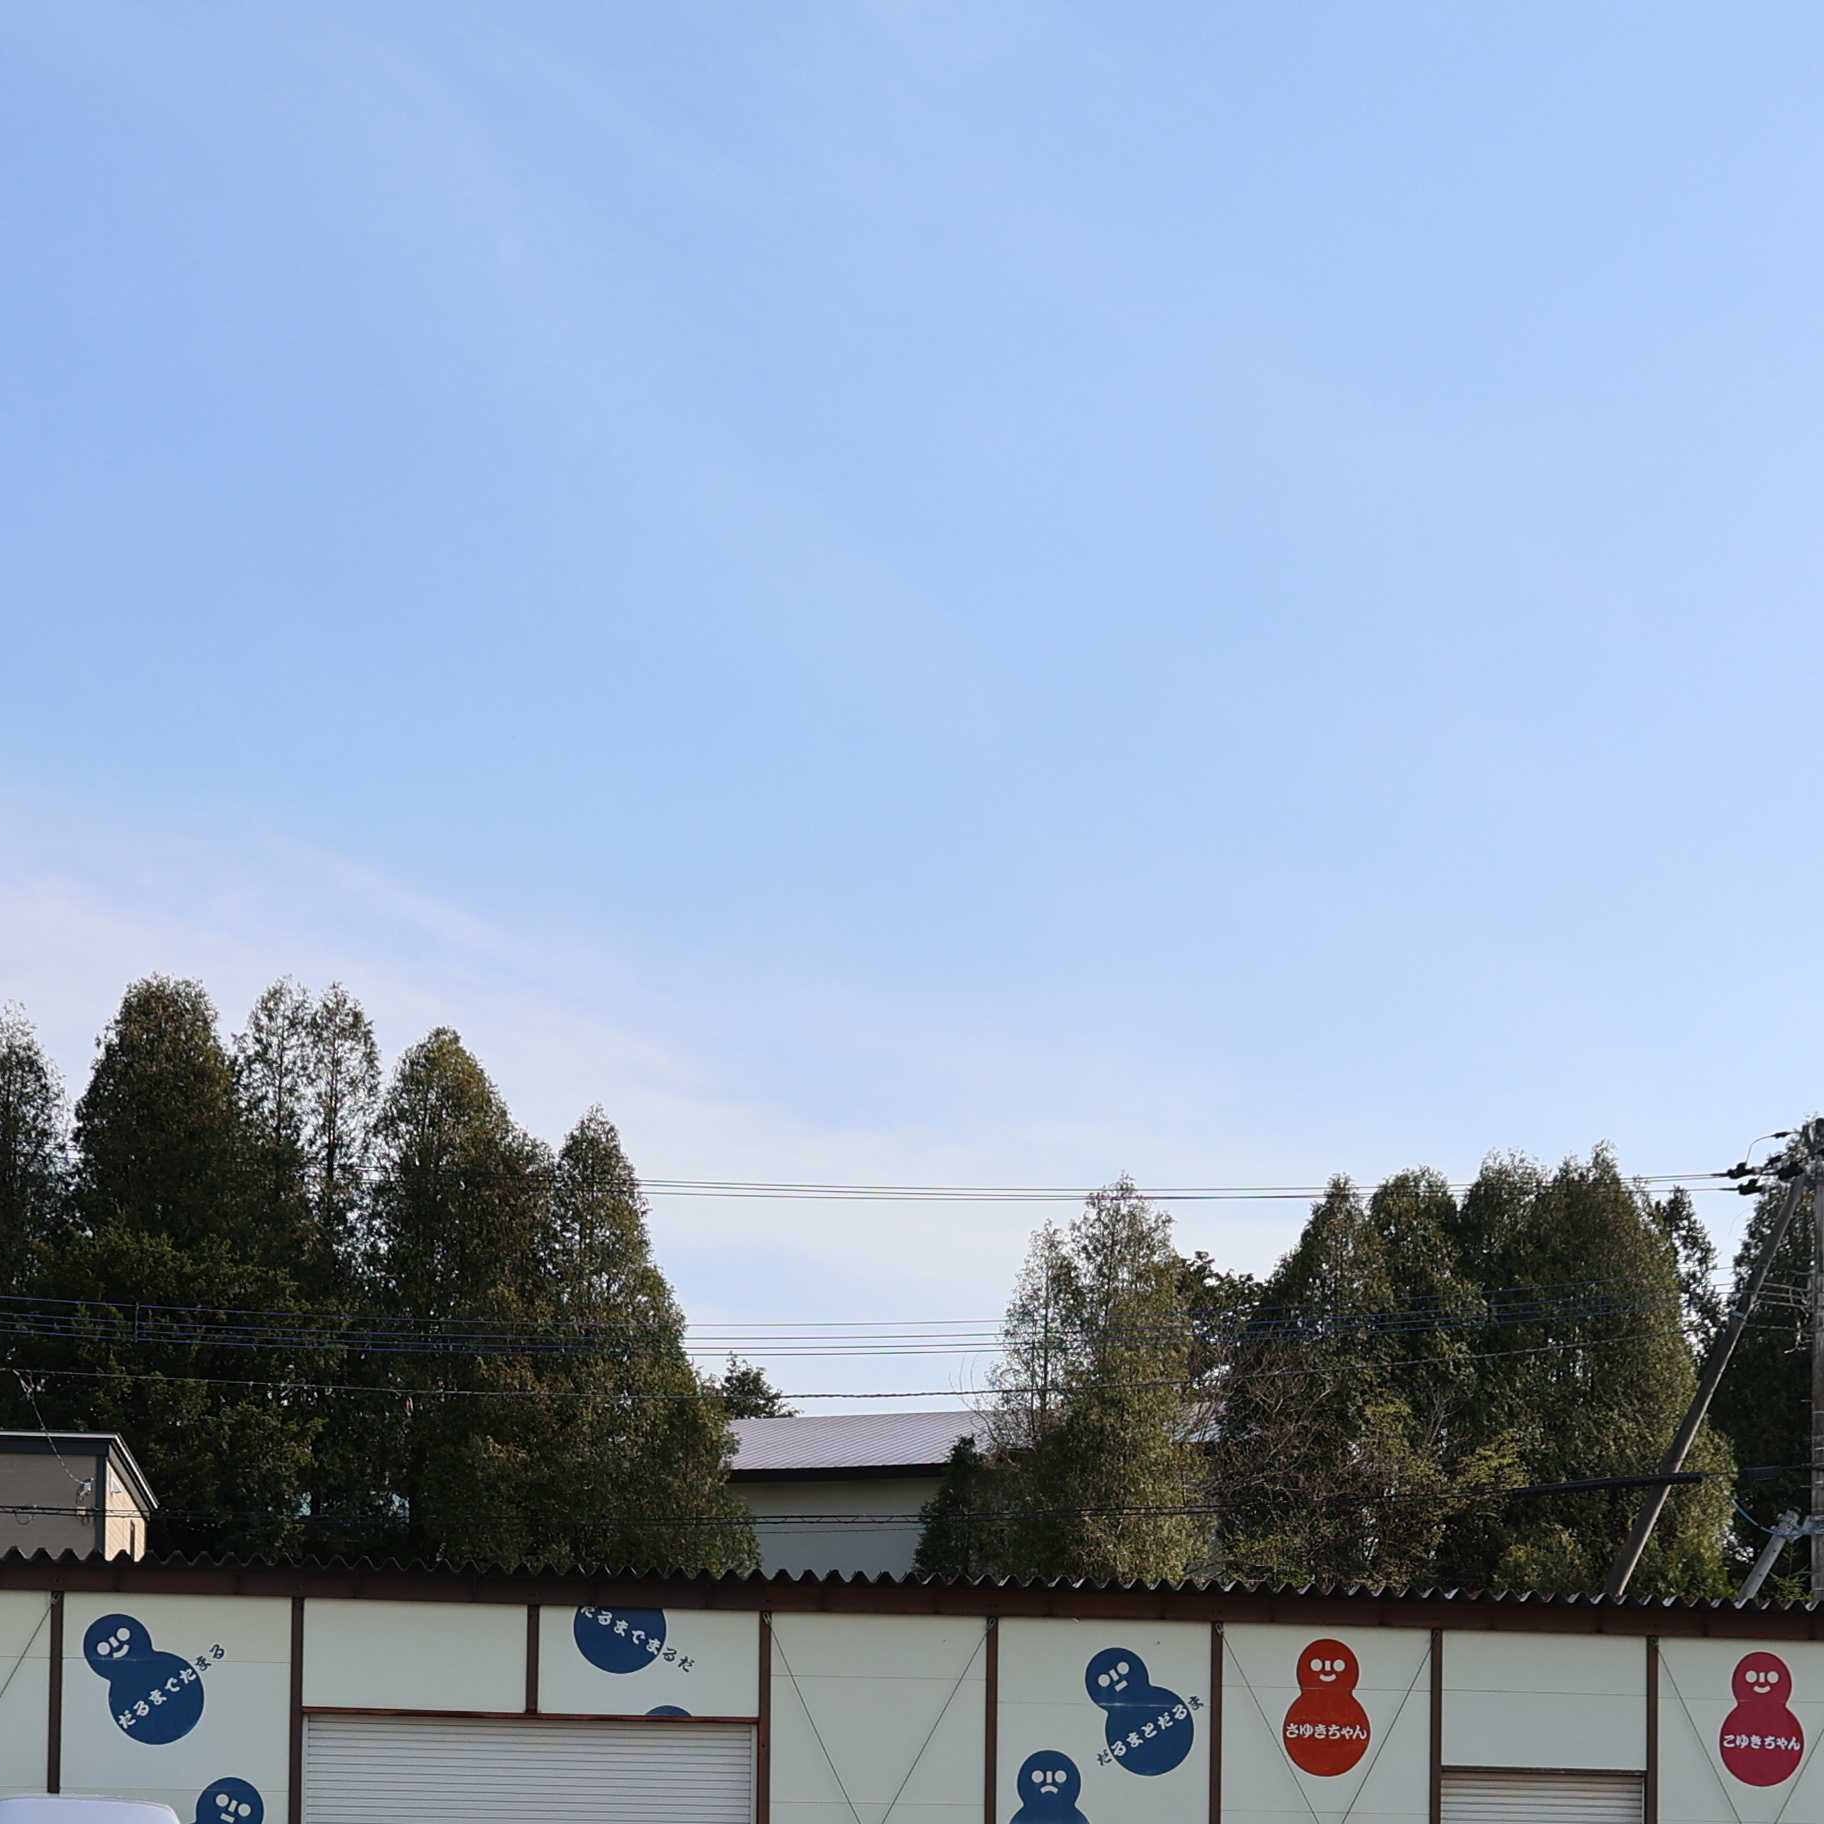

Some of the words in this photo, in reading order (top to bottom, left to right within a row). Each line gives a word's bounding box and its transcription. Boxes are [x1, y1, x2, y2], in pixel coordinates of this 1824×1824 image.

[117, 1643, 226, 1730] だるまでたまる
[1095, 1695, 1205, 1767] だるまとだるま
[1285, 1722, 1368, 1740] さゆきちゃん
[1722, 1733, 1801, 1751] こゆきちゃん
